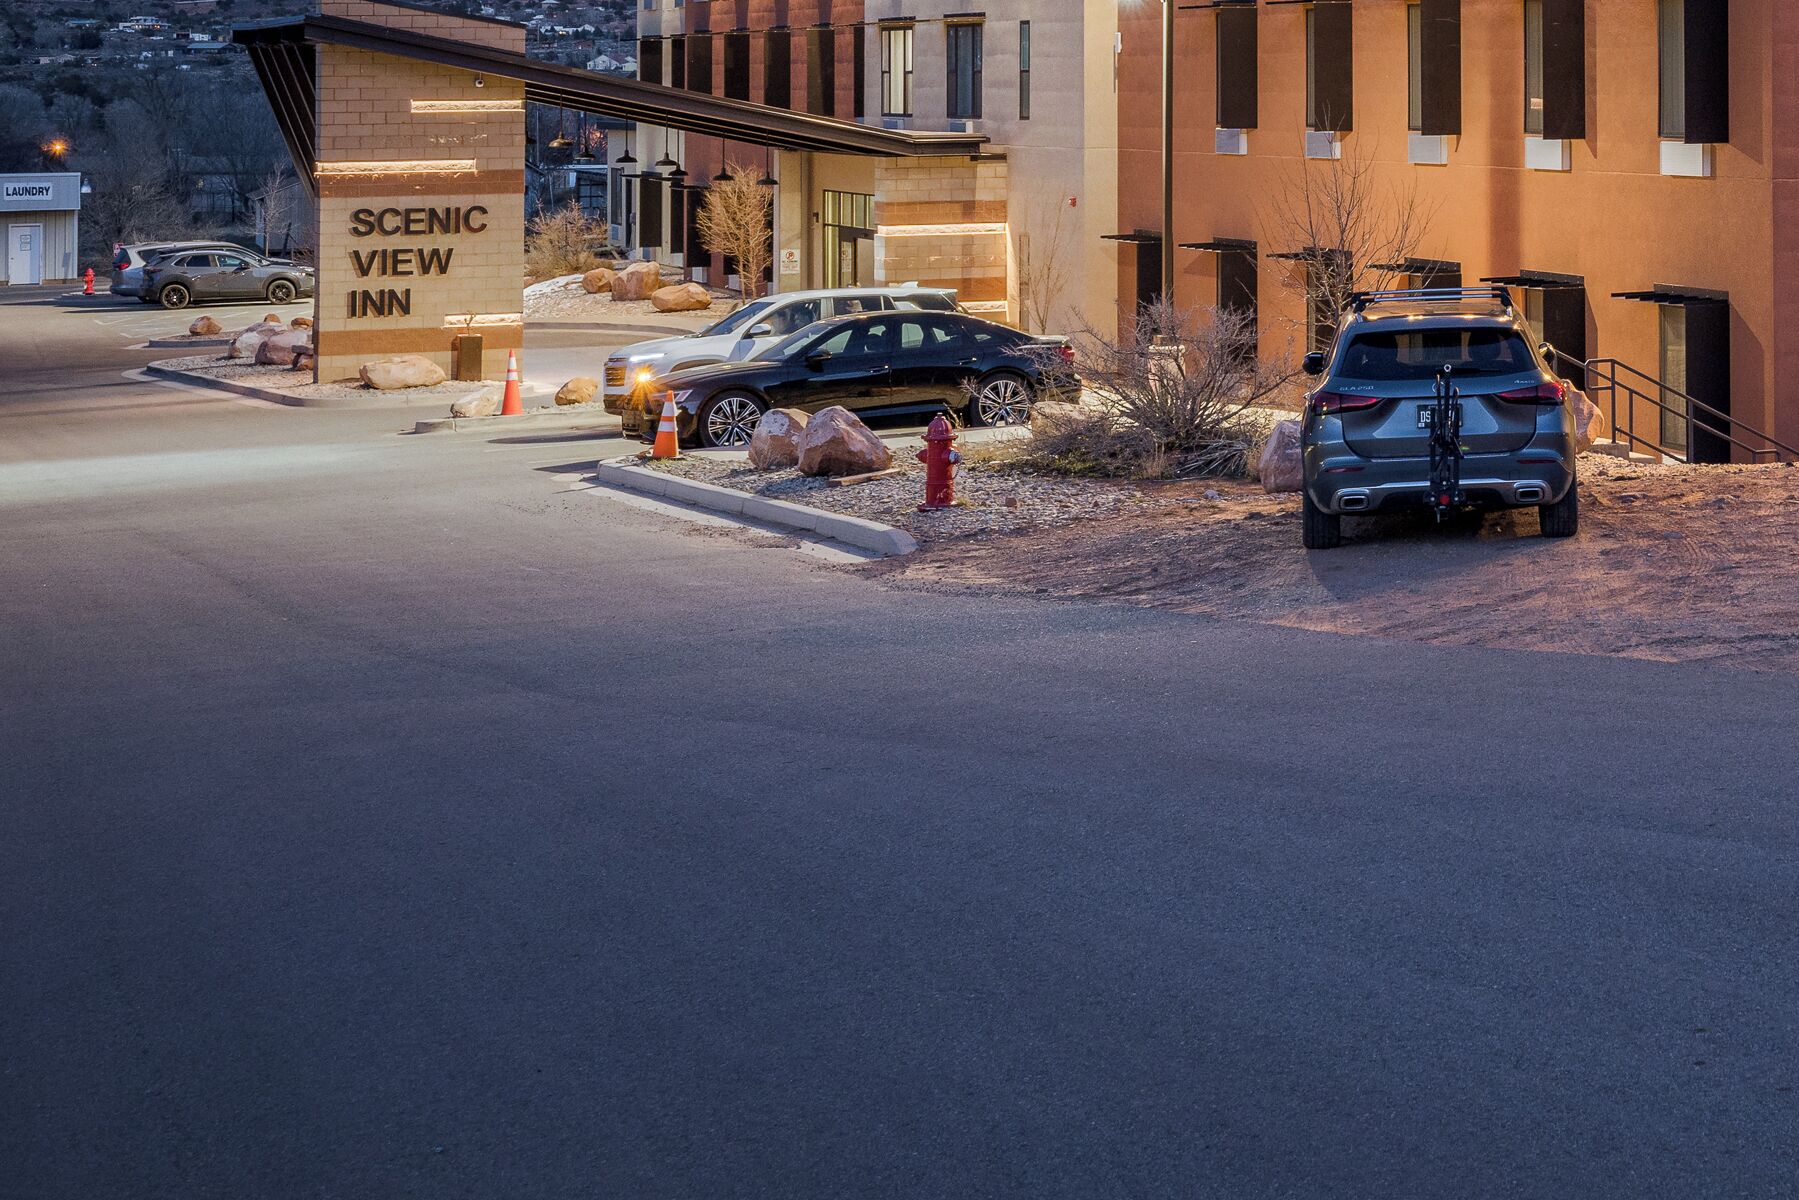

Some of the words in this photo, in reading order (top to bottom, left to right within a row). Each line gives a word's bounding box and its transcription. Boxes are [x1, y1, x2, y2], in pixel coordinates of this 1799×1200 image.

[5, 185, 51, 197] LAUNDRY
[351, 205, 489, 237] SCENIC
[352, 247, 454, 277] VIEW
[350, 288, 411, 318] INN
